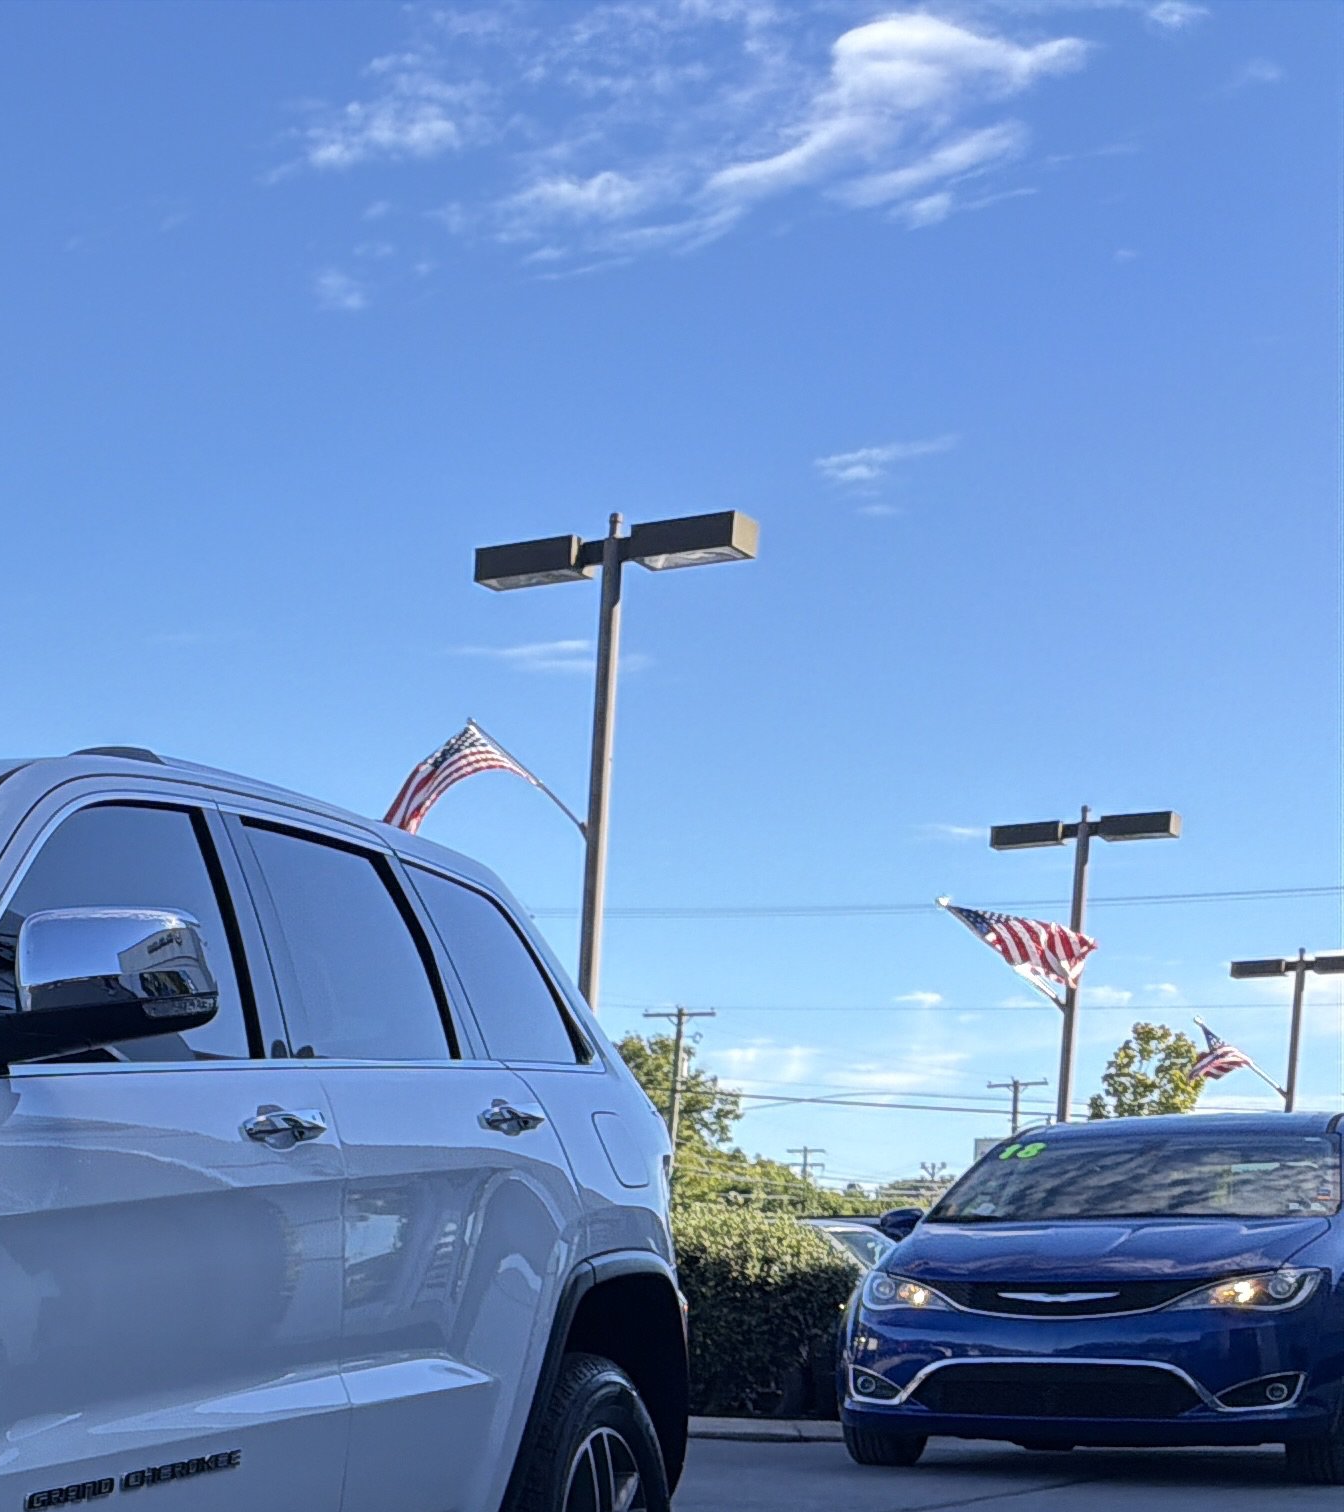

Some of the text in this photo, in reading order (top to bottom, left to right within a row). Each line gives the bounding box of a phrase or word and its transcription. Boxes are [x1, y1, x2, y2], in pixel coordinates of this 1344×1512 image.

[998, 1142, 1047, 1159] 18
[23, 1448, 243, 1512] GRAND CHEROKEE
